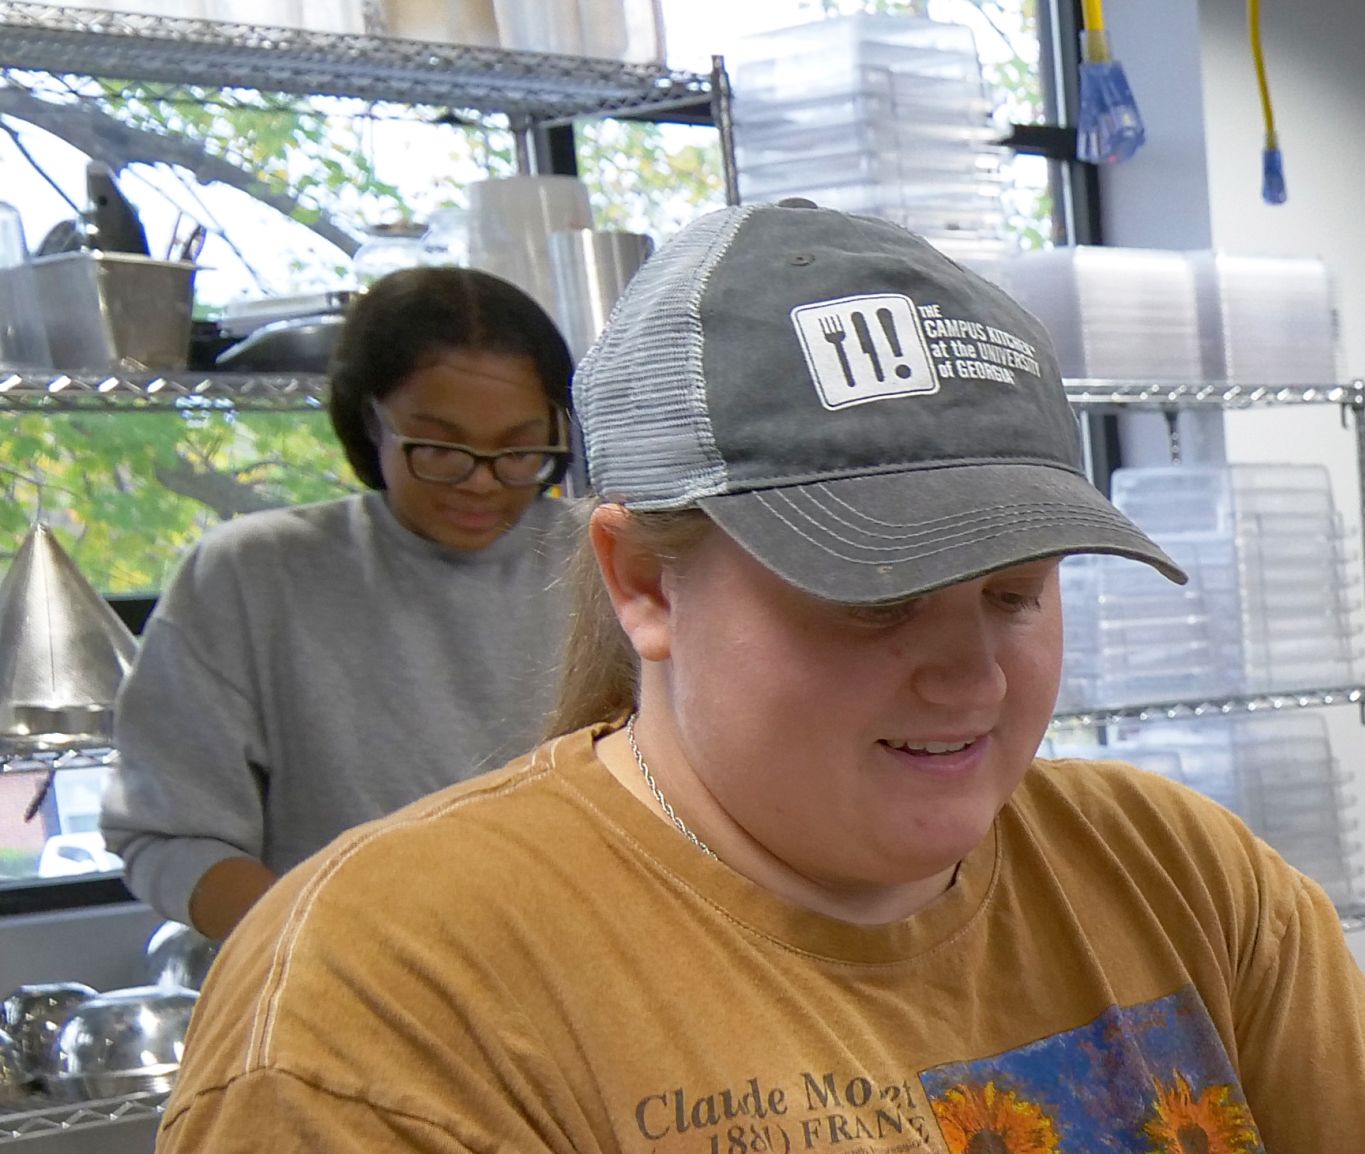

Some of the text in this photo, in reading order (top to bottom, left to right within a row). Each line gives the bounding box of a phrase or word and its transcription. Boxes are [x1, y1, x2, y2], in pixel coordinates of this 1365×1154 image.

[918, 305, 942, 318] THE
[924, 320, 987, 341] CAMPUS
[931, 340, 1041, 378] at the UNIVERSITY
[938, 362, 955, 378] of
